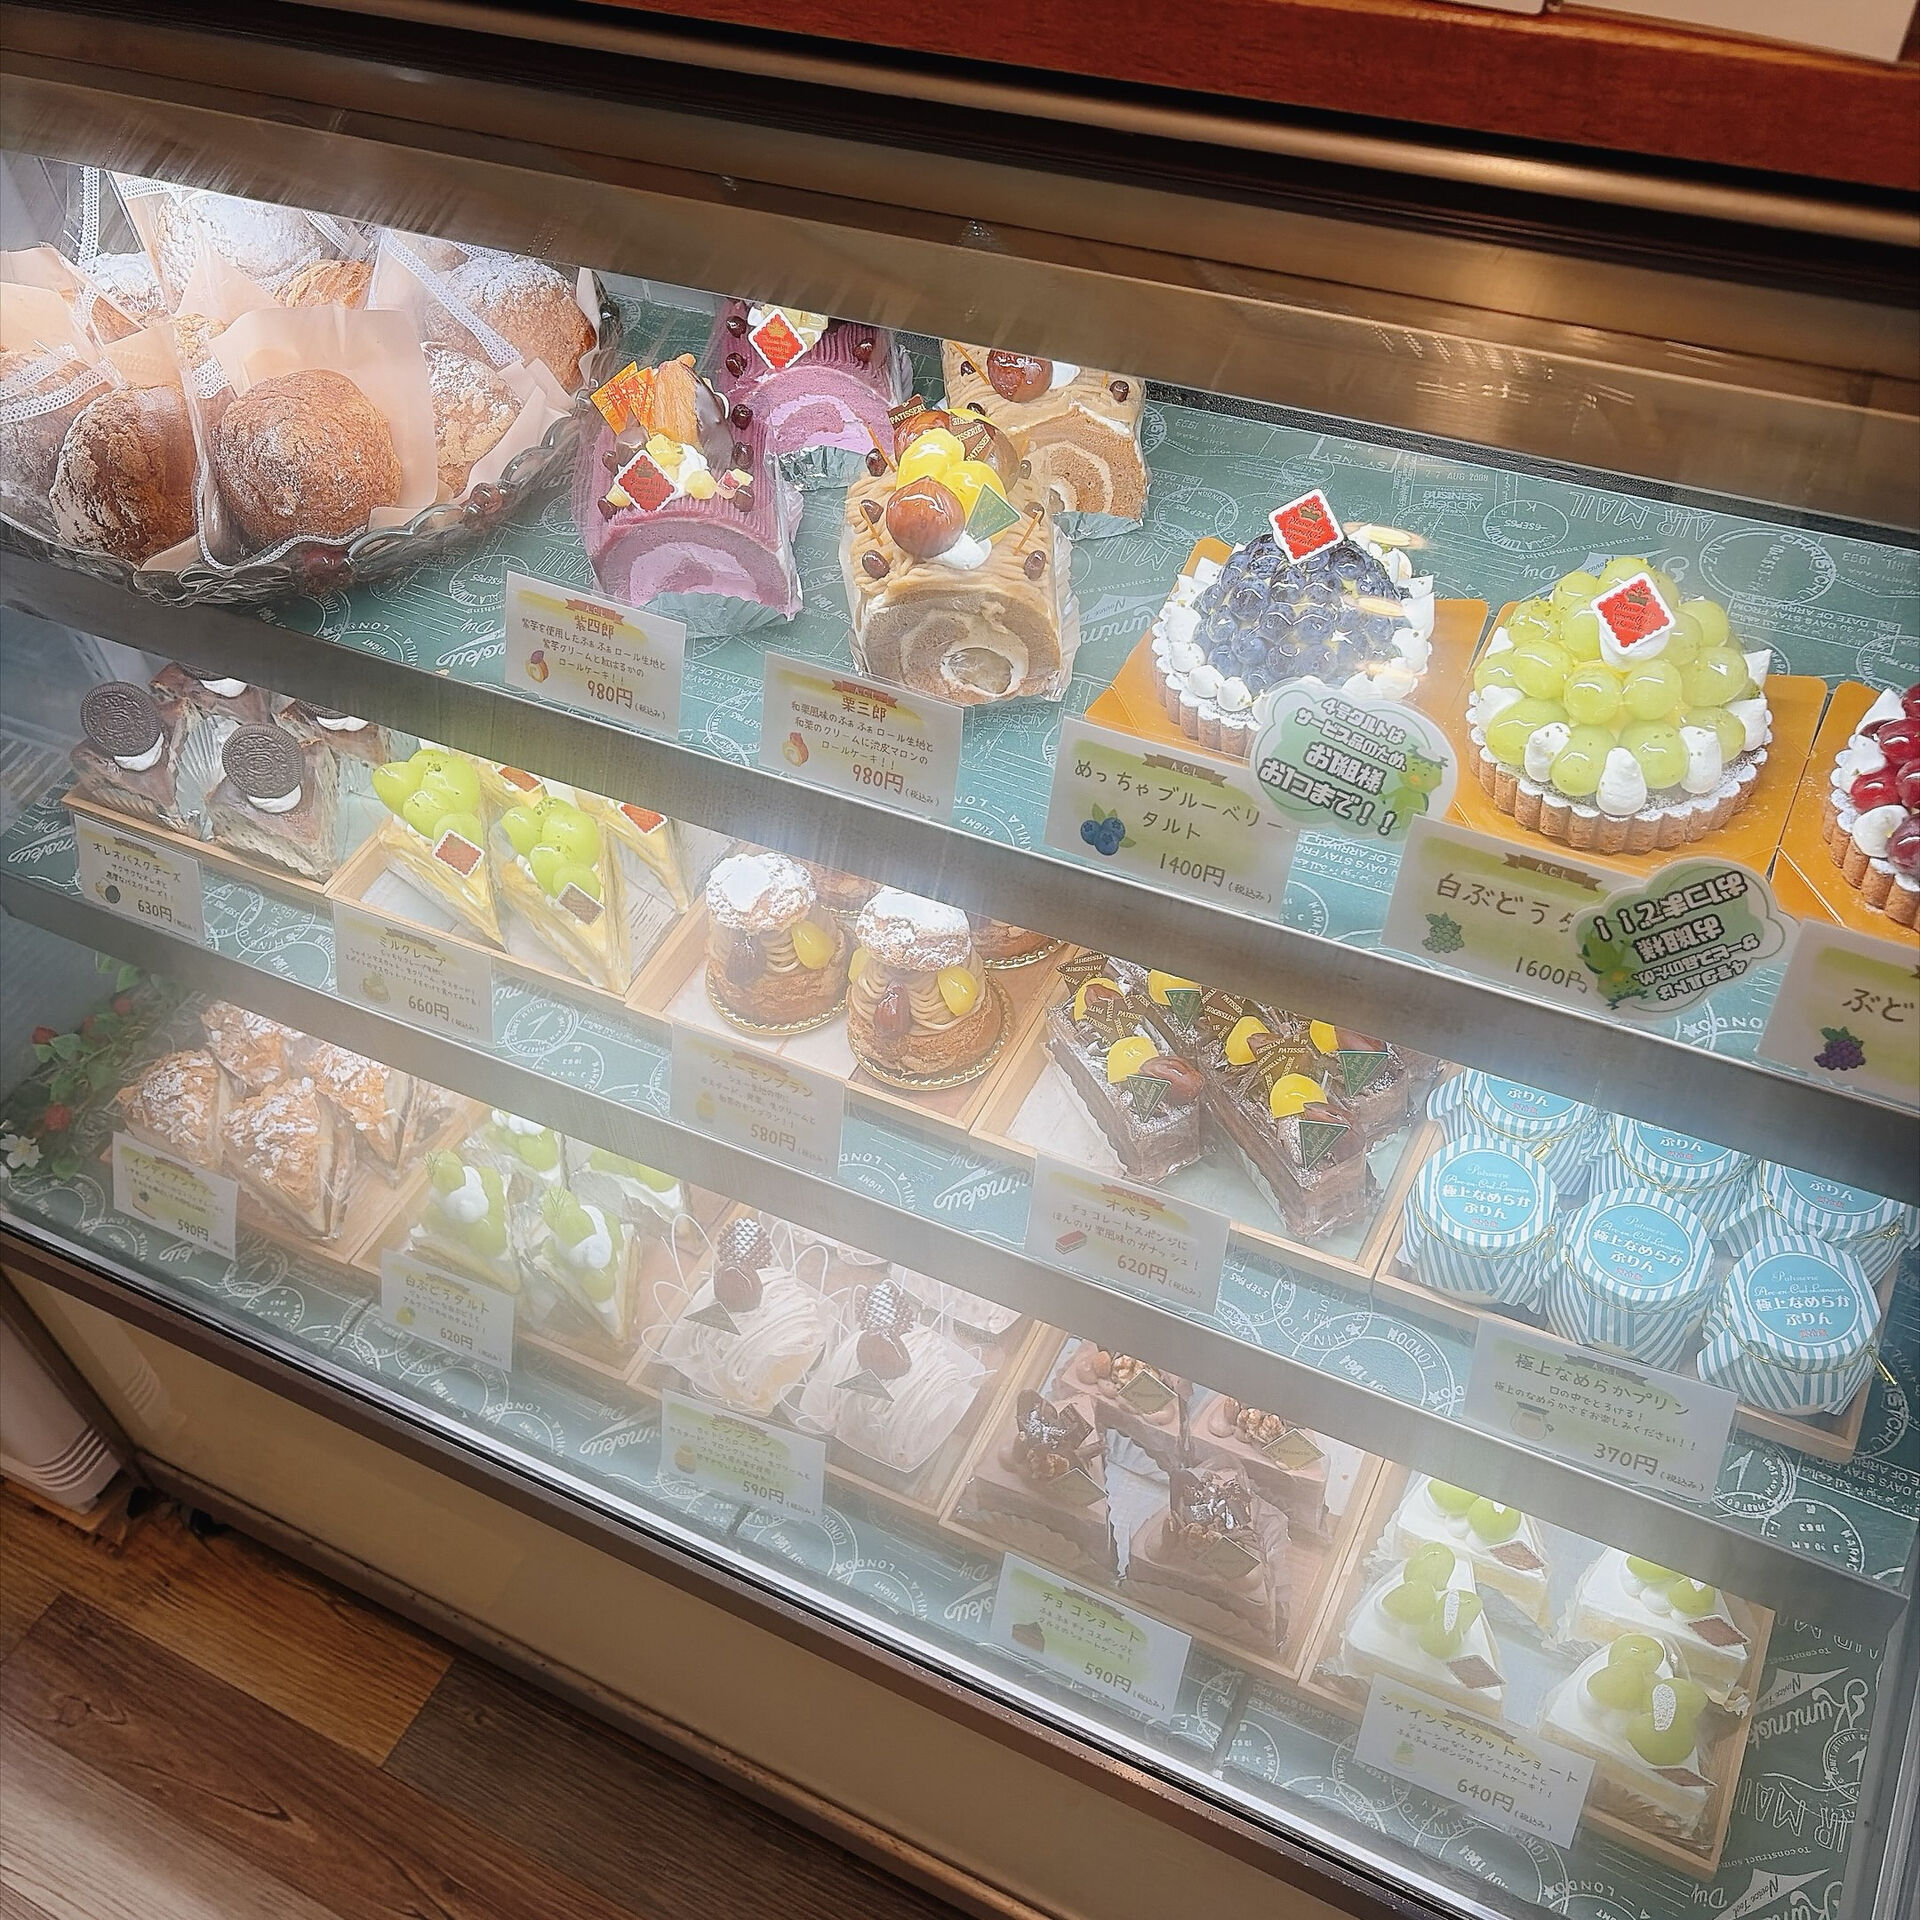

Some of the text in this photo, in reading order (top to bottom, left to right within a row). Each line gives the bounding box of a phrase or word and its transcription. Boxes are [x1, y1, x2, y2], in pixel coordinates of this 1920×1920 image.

[574, 614, 615, 639] 紫四郎
[587, 680, 633, 709] 980円
[842, 696, 887, 723] 栗三郎
[1321, 698, 1406, 745] 4号タルトは
[852, 764, 904, 794] 980円
[1074, 759, 1287, 829] めっちゃブルーベリー
[1143, 812, 1202, 841] タルト
[1159, 852, 1226, 887] 1400円
[138, 900, 172, 922] 630円
[378, 936, 447, 967] ミルクレープ
[1514, 956, 1588, 994] 1600円
[1658, 958, 1748, 1001] 4号タルトは
[408, 995, 449, 1022] 660円
[711, 1054, 814, 1097] シューモンブラン
[751, 1124, 796, 1152] 580円
[1106, 1200, 1151, 1221] オペラ
[1442, 1183, 1532, 1208] 極上なめらか
[178, 1219, 208, 1242] 590円
[1071, 1204, 1187, 1250] チョコレートスポンジに
[1592, 1229, 1684, 1268] 極上なめらか
[1117, 1255, 1167, 1284] 620円
[405, 1274, 489, 1314] 白ぶどうタルト
[1754, 1294, 1851, 1312] 極上なめらか
[440, 1327, 473, 1350] 620円
[1515, 1353, 1690, 1415] 極上なめらかプリン
[1550, 1386, 1643, 1421] 口の中でとろける！
[1593, 1443, 1658, 1475] 370円
[743, 1480, 784, 1504] 590円
[1042, 1591, 1140, 1644] チョコショート
[1084, 1662, 1132, 1694] 590円
[1380, 1695, 1579, 1784] シャインマスカットショート
[1457, 1778, 1515, 1814] 640円
